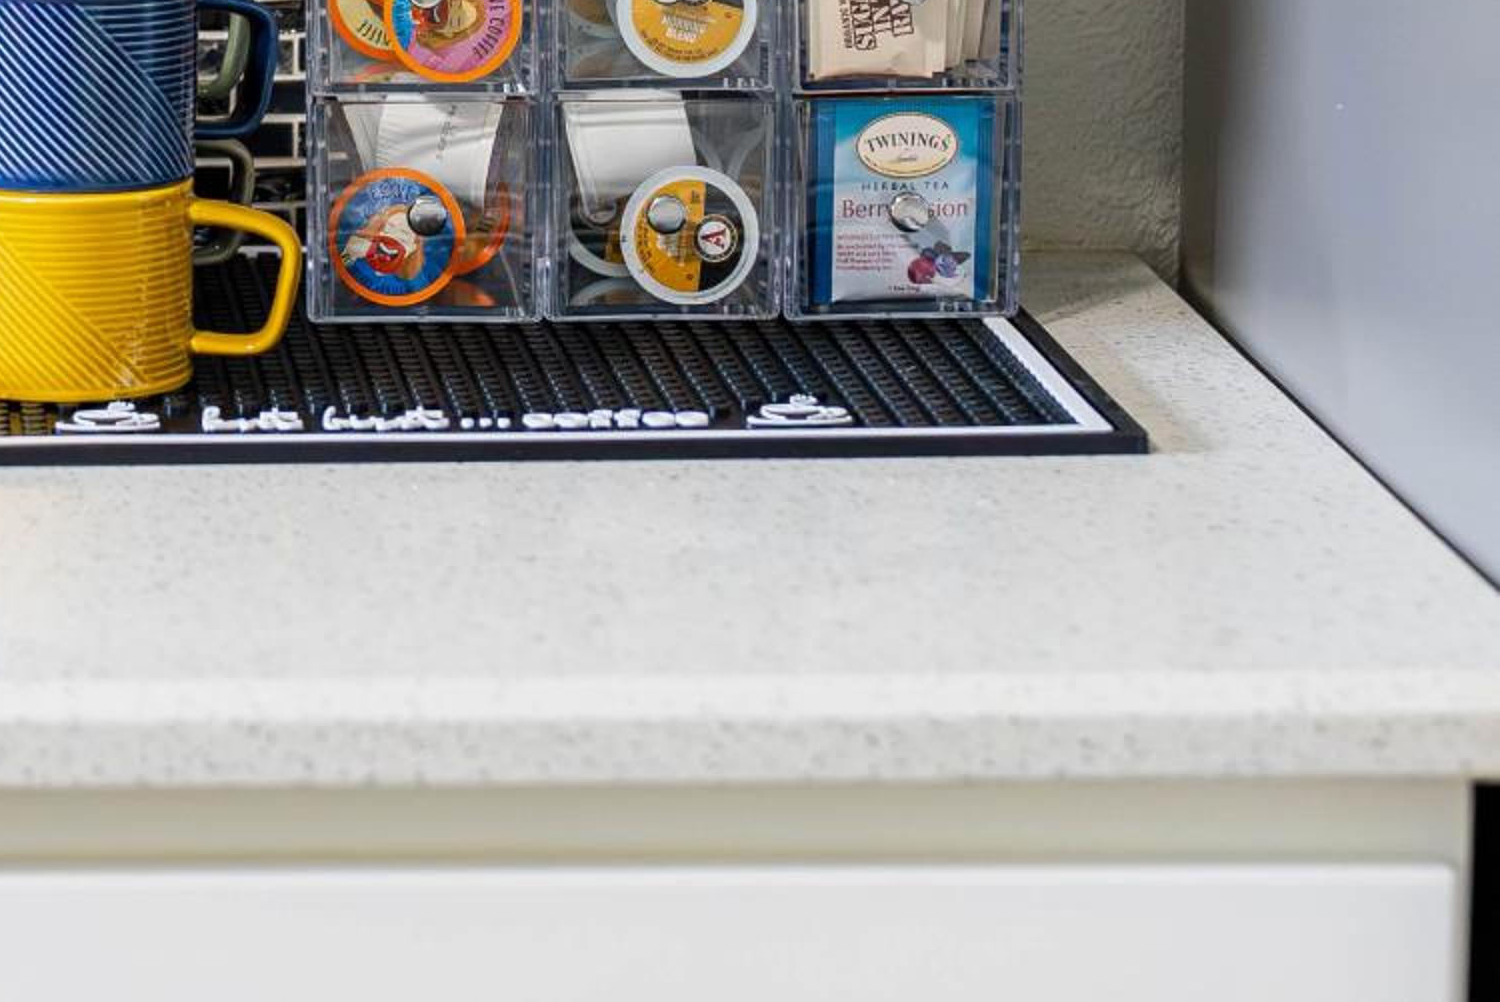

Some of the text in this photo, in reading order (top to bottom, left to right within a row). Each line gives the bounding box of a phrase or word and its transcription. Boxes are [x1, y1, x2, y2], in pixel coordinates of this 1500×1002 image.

[865, 132, 952, 153] TWININGS
[861, 181, 950, 192] HERBAL TEA
